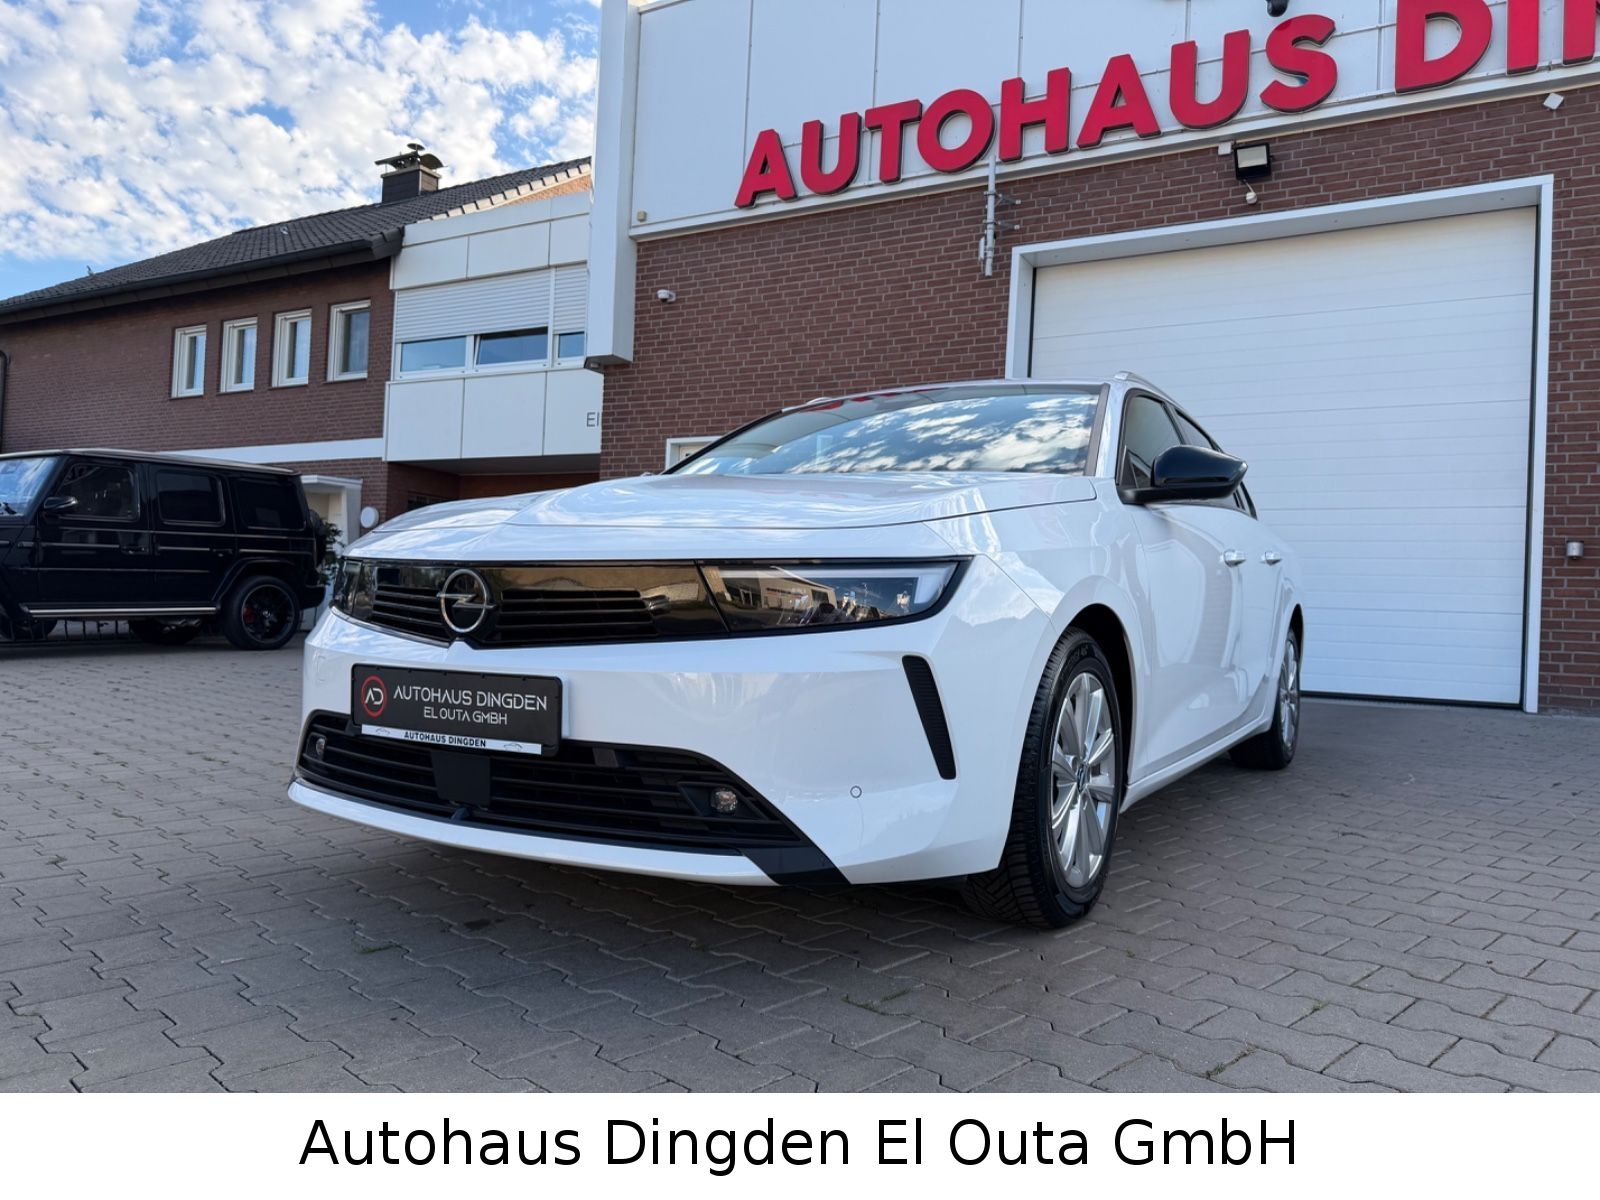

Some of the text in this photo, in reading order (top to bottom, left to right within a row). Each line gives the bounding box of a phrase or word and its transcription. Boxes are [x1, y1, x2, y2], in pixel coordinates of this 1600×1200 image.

[735, 15, 1338, 208] AUTOHAUS
[393, 685, 547, 711] AUTOHAUS DINGDEN
[423, 706, 508, 725] EL OUTA GMBH
[403, 731, 486, 748] AUTOHAUS DINGDEN
